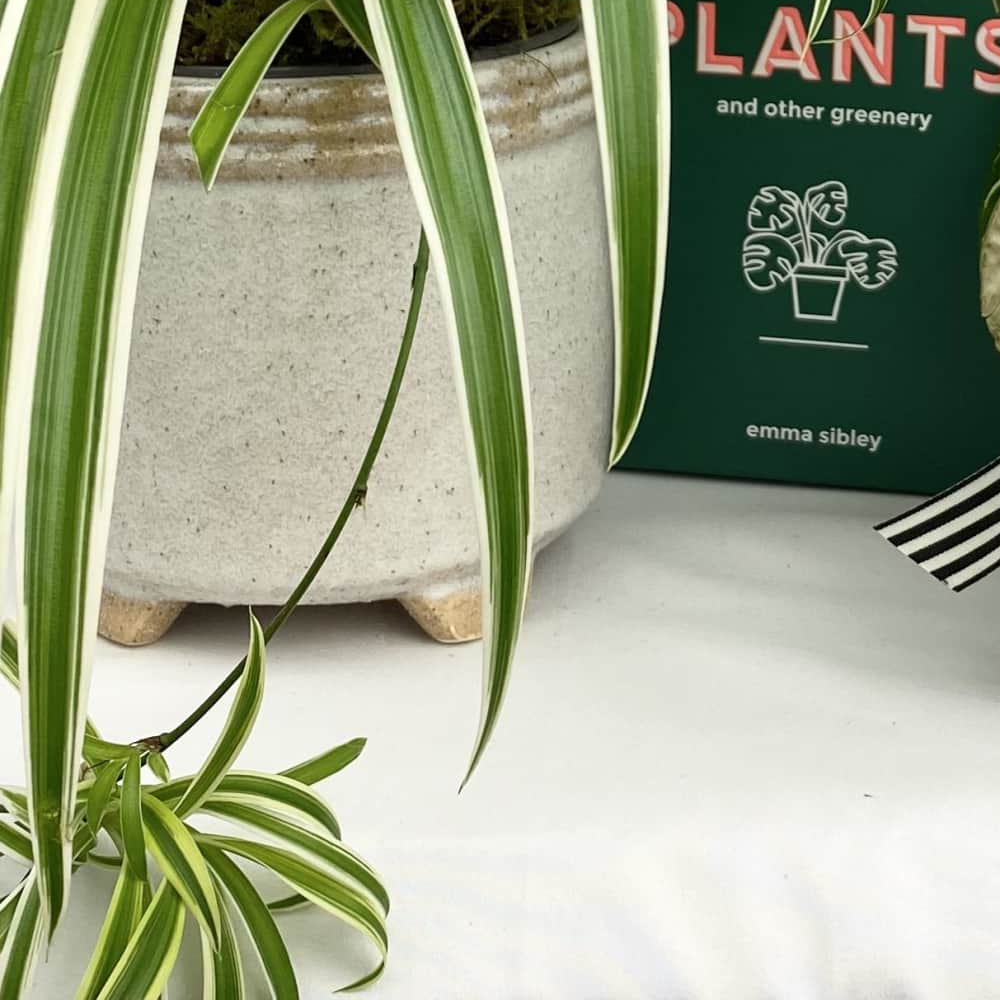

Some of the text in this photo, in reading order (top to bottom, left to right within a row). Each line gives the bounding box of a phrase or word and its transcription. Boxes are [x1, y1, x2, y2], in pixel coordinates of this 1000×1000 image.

[716, 97, 933, 132] and other greenery
[745, 423, 882, 452] emma sibley
